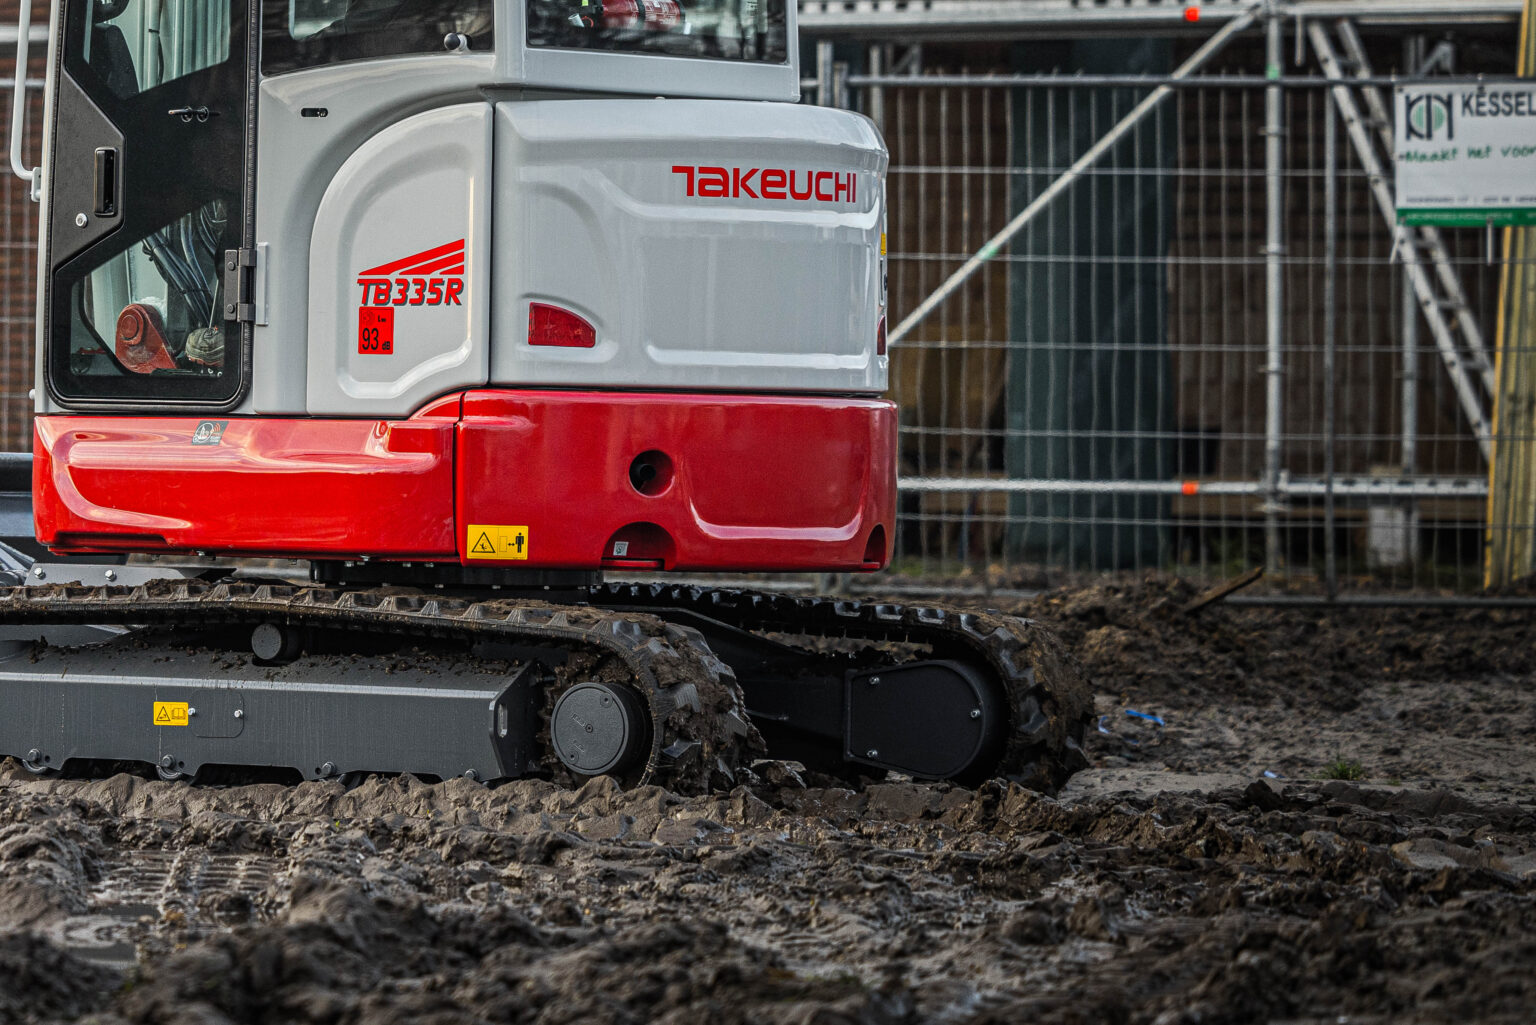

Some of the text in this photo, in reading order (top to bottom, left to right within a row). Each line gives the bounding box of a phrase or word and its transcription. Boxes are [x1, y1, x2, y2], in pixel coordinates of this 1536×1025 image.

[671, 165, 857, 203] TAKEUCHI
[356, 277, 465, 307] TB335R
[362, 327, 379, 351] 93
